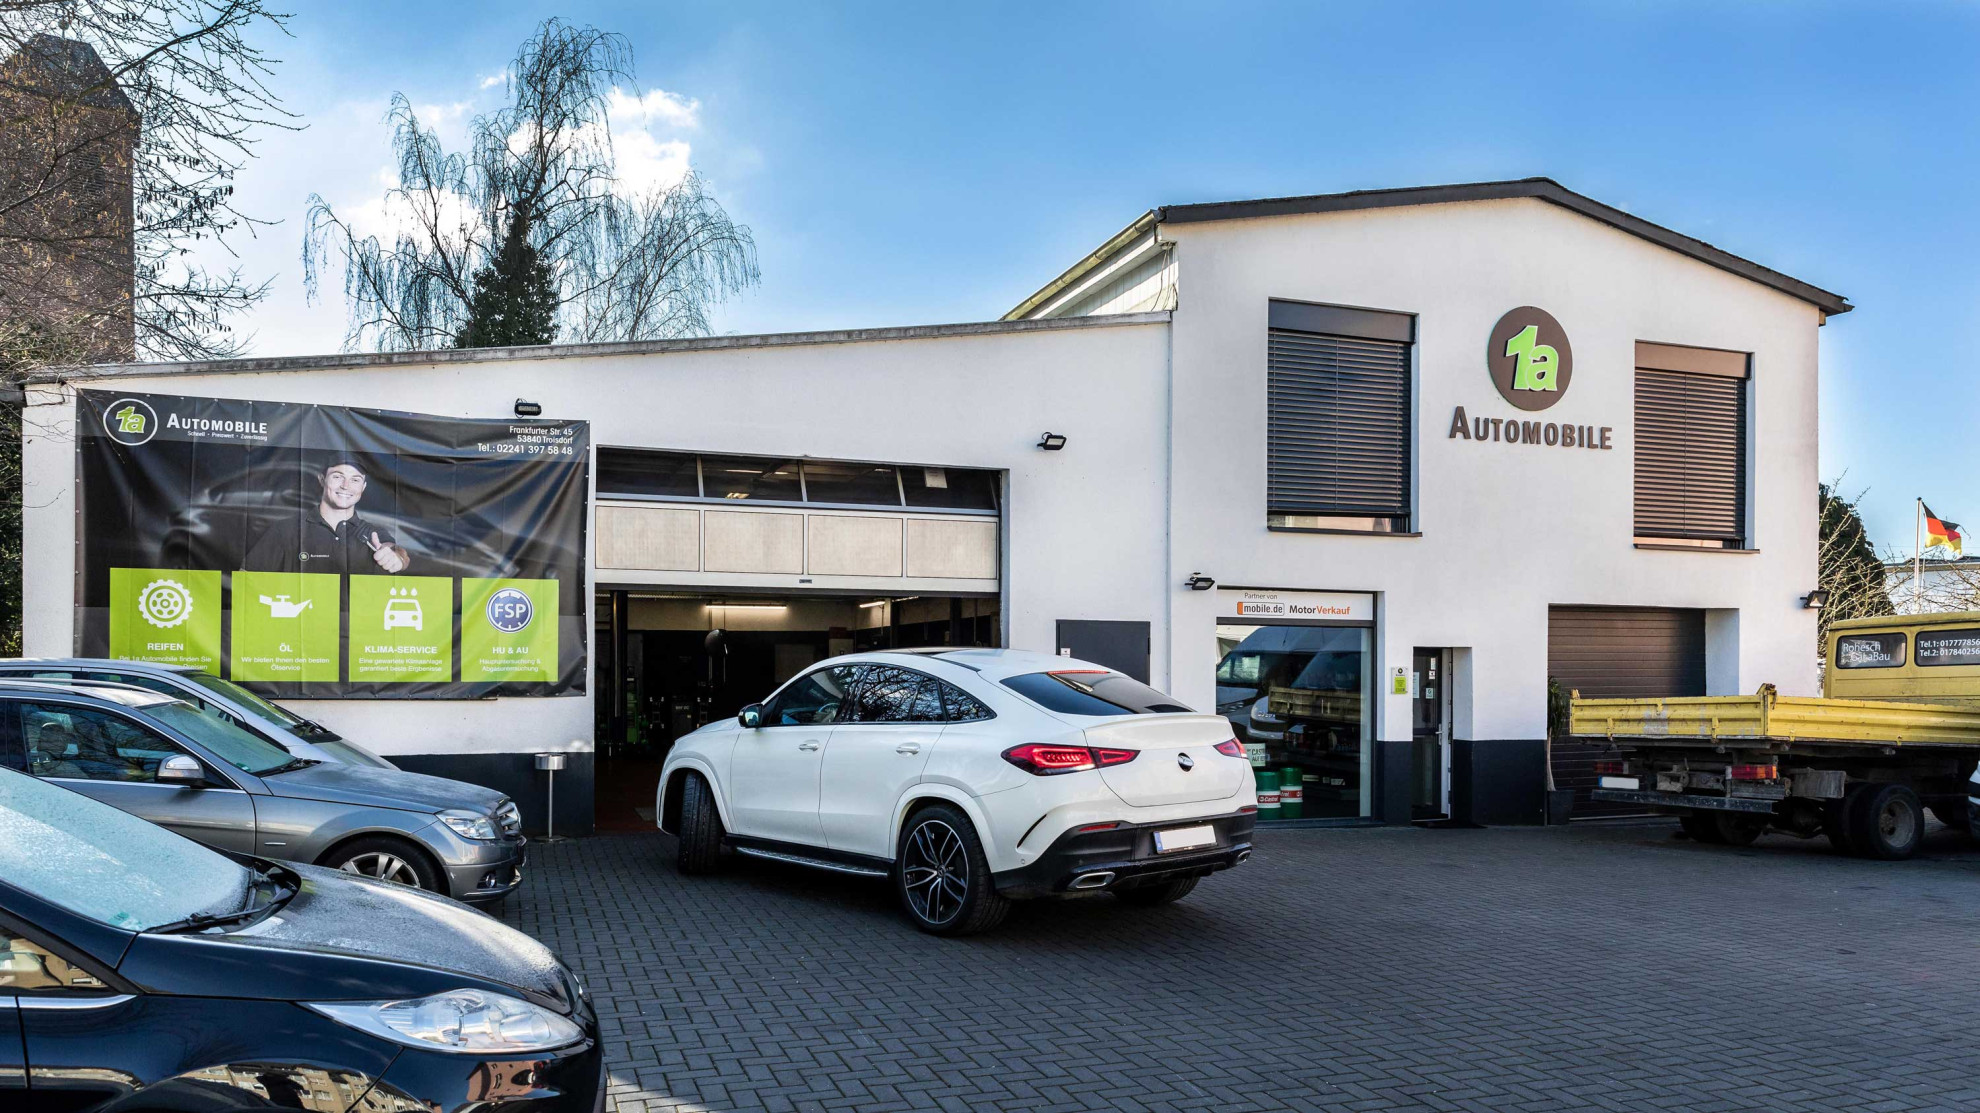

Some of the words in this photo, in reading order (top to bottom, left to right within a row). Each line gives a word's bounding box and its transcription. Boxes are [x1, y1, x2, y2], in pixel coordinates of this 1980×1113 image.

[1505, 325, 1558, 392] 1a
[115, 406, 146, 433] 1a
[166, 413, 268, 434] AUTOMOBILE
[509, 426, 548, 435] Frankfurter
[550, 427, 562, 436] Str.
[564, 428, 573, 436] 45
[1449, 406, 1613, 450] AUTOMOBILE
[517, 435, 542, 443] 53840
[477, 443, 496, 453] Tel.:
[496, 443, 525, 453] 02241
[528, 445, 545, 454] 397
[547, 445, 559, 455] 58
[561, 446, 573, 455] 48
[1244, 592, 1265, 600] Partner
[494, 603, 527, 619] FSP
[1244, 604, 1283, 613] mobile.de
[147, 643, 184, 651] REIFEN
[279, 643, 293, 652] ÖL
[364, 645, 438, 654] KLIMA-SERVICE
[1919, 649, 1939, 657] Tel.2:
